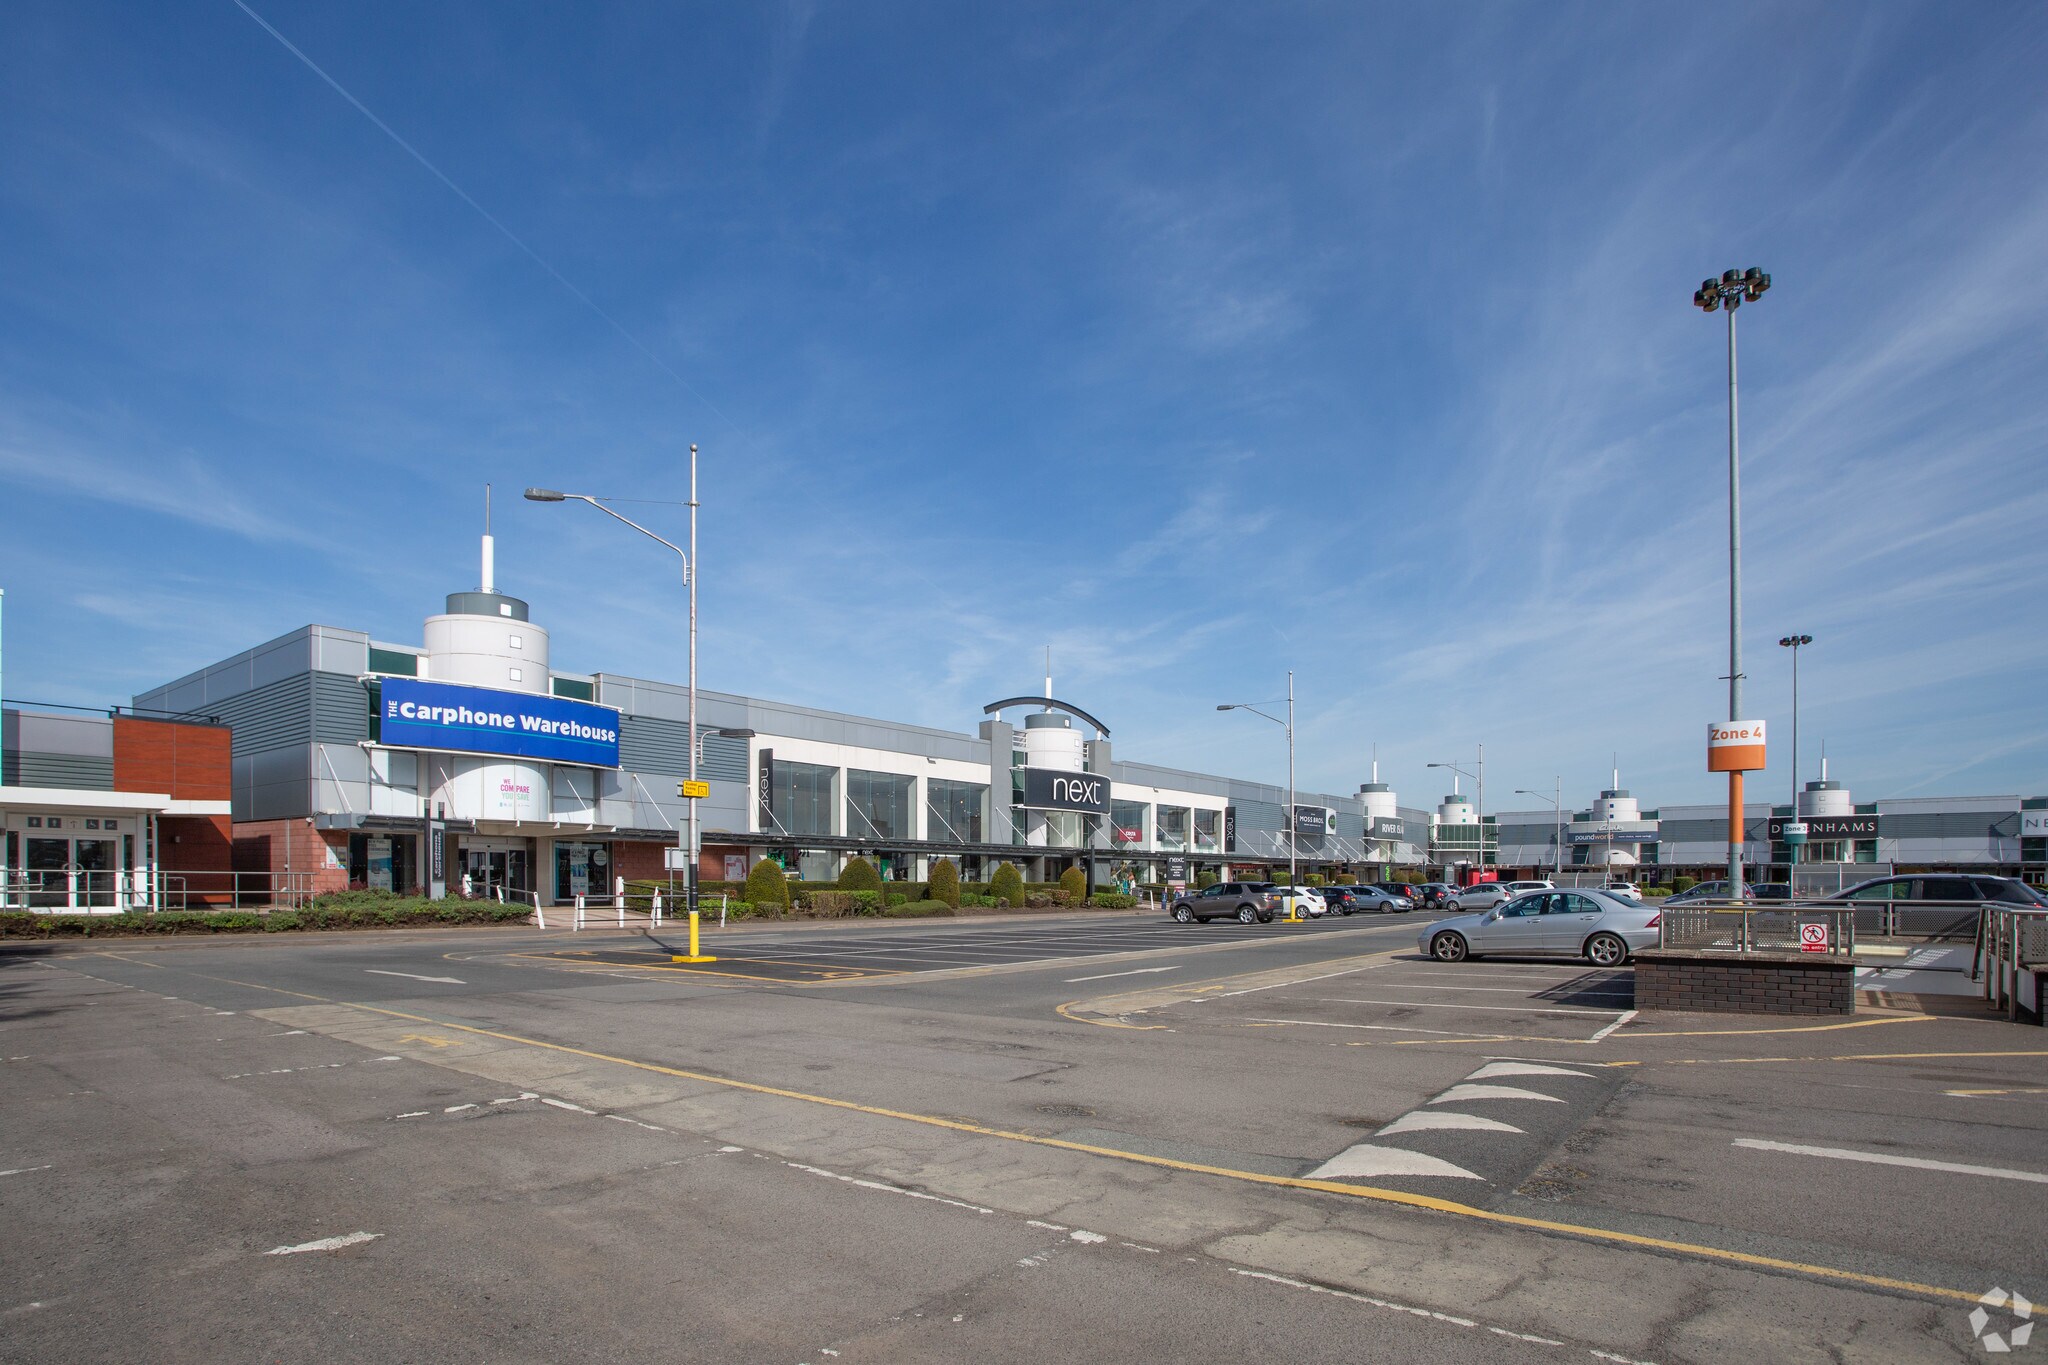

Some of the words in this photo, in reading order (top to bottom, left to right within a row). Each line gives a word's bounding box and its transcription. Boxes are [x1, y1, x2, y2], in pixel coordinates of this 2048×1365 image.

[388, 700, 397, 717] THE
[400, 702, 515, 728] Carphone
[520, 714, 616, 742] Warehouse
[1711, 729, 1749, 741] Zone
[1753, 726, 1762, 738] 4
[761, 767, 769, 808] next
[1053, 778, 1101, 805] next
[1381, 823, 1396, 833] RIVER
[1771, 822, 1875, 833] DNHAMS
